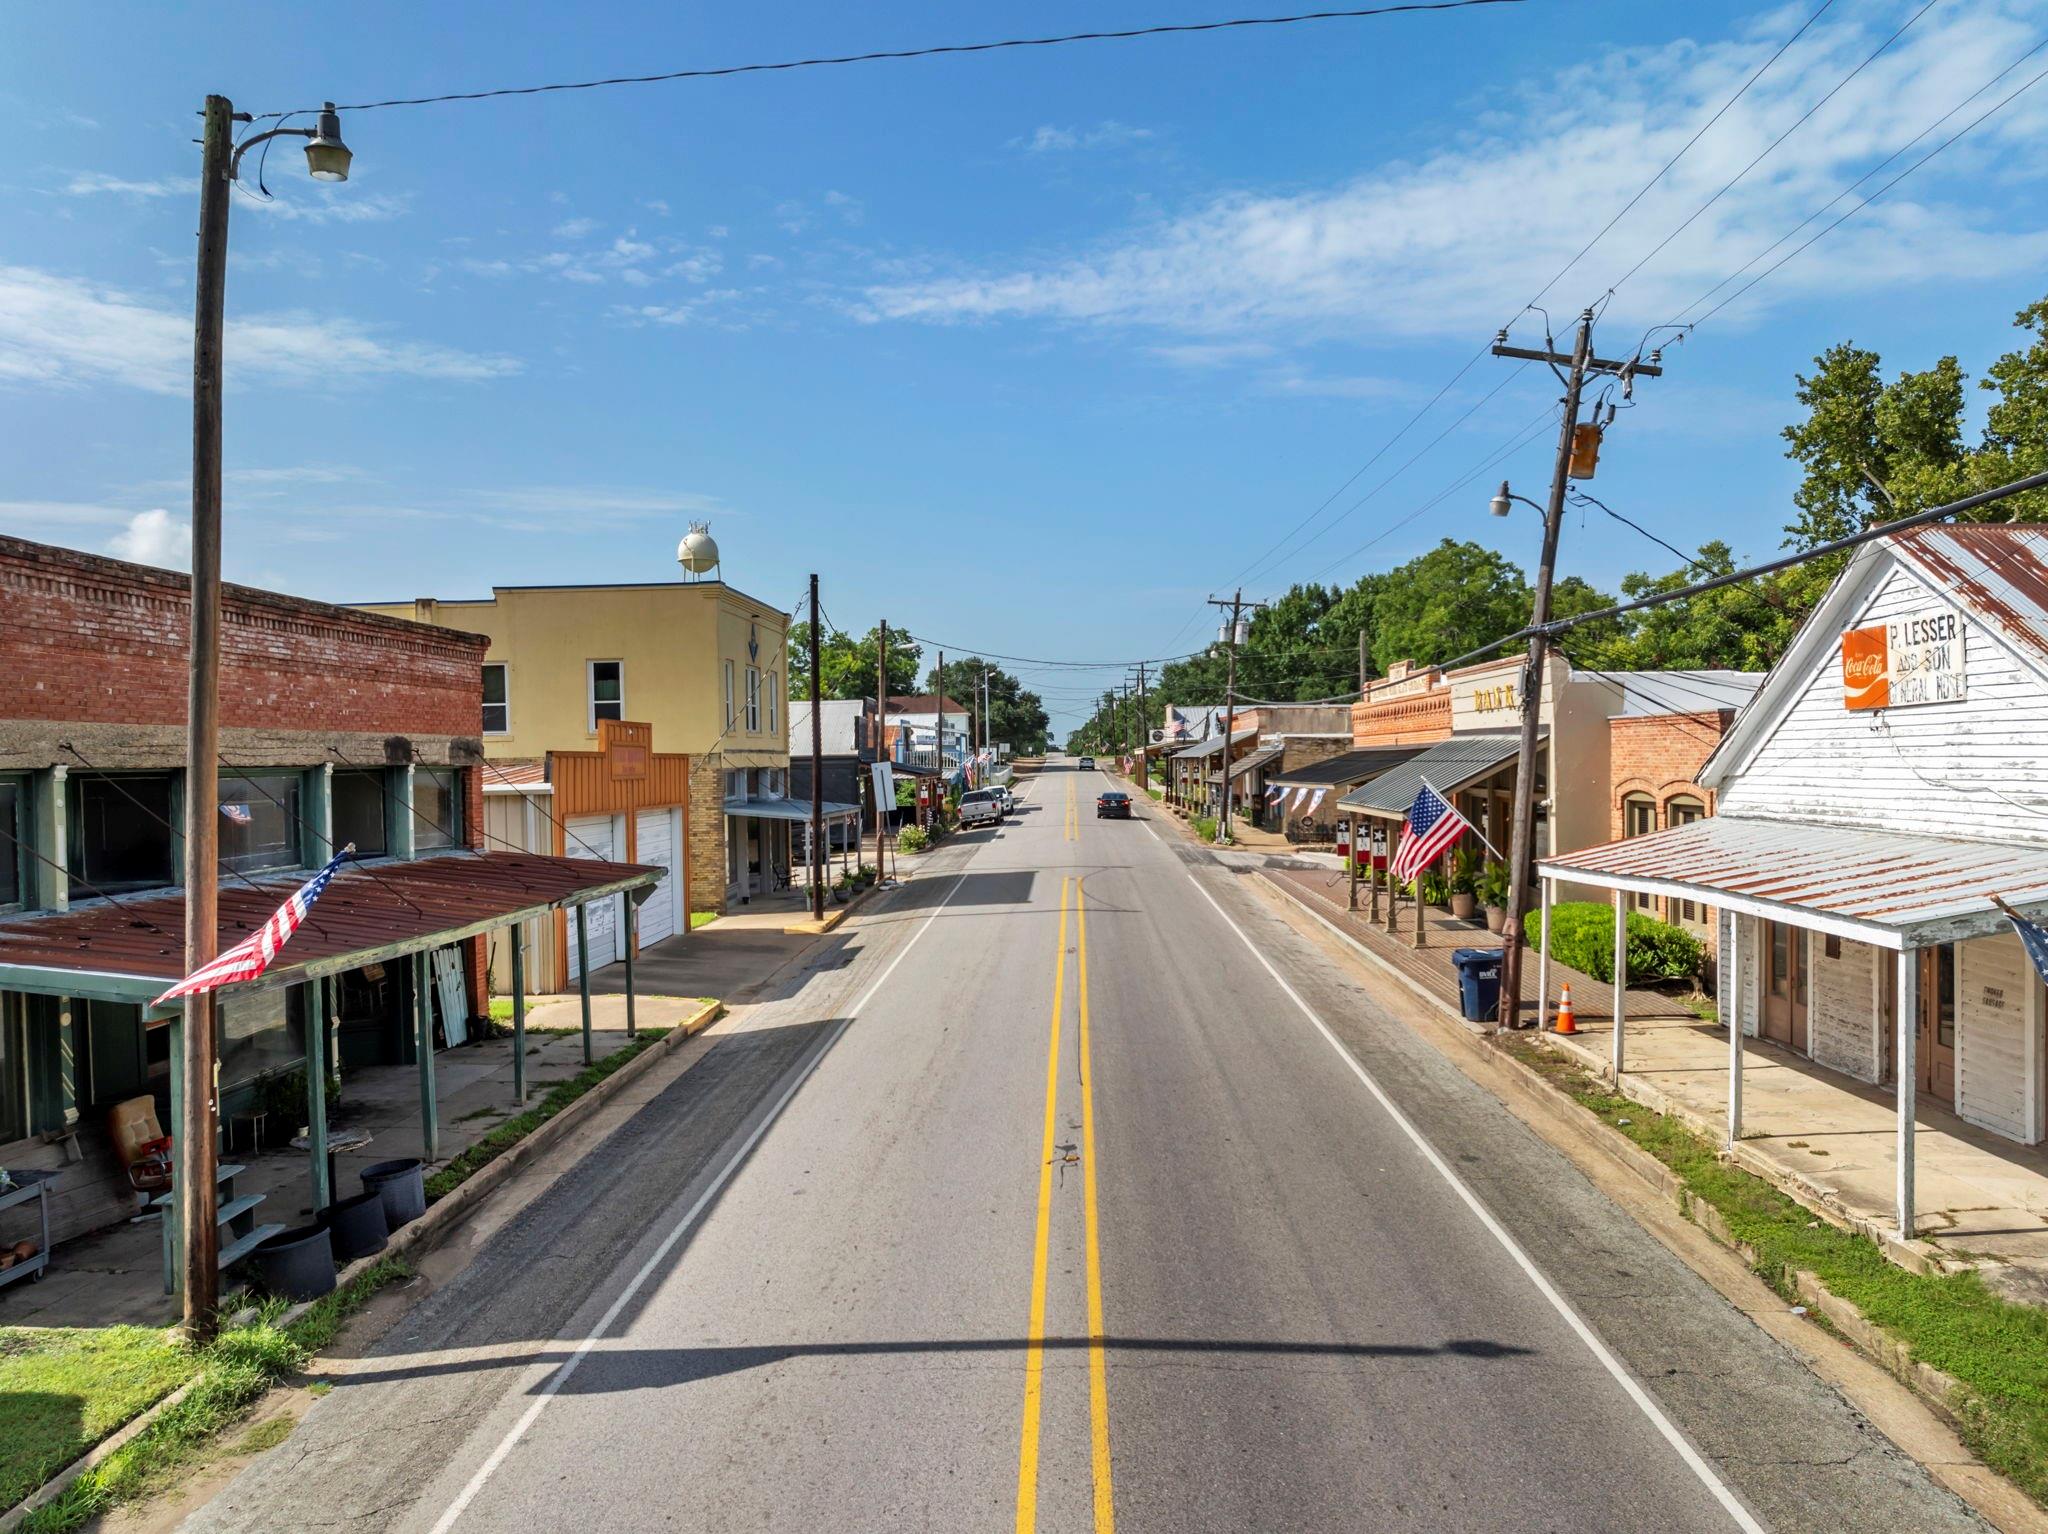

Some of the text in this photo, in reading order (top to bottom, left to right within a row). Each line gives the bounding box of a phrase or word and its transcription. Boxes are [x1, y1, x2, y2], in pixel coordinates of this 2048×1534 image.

[1904, 614, 1956, 647] LESSER
[1845, 654, 1883, 678] Coca-Cola
[1924, 645, 1951, 673] SON
[1888, 672, 1963, 705] GNERAL MDE
